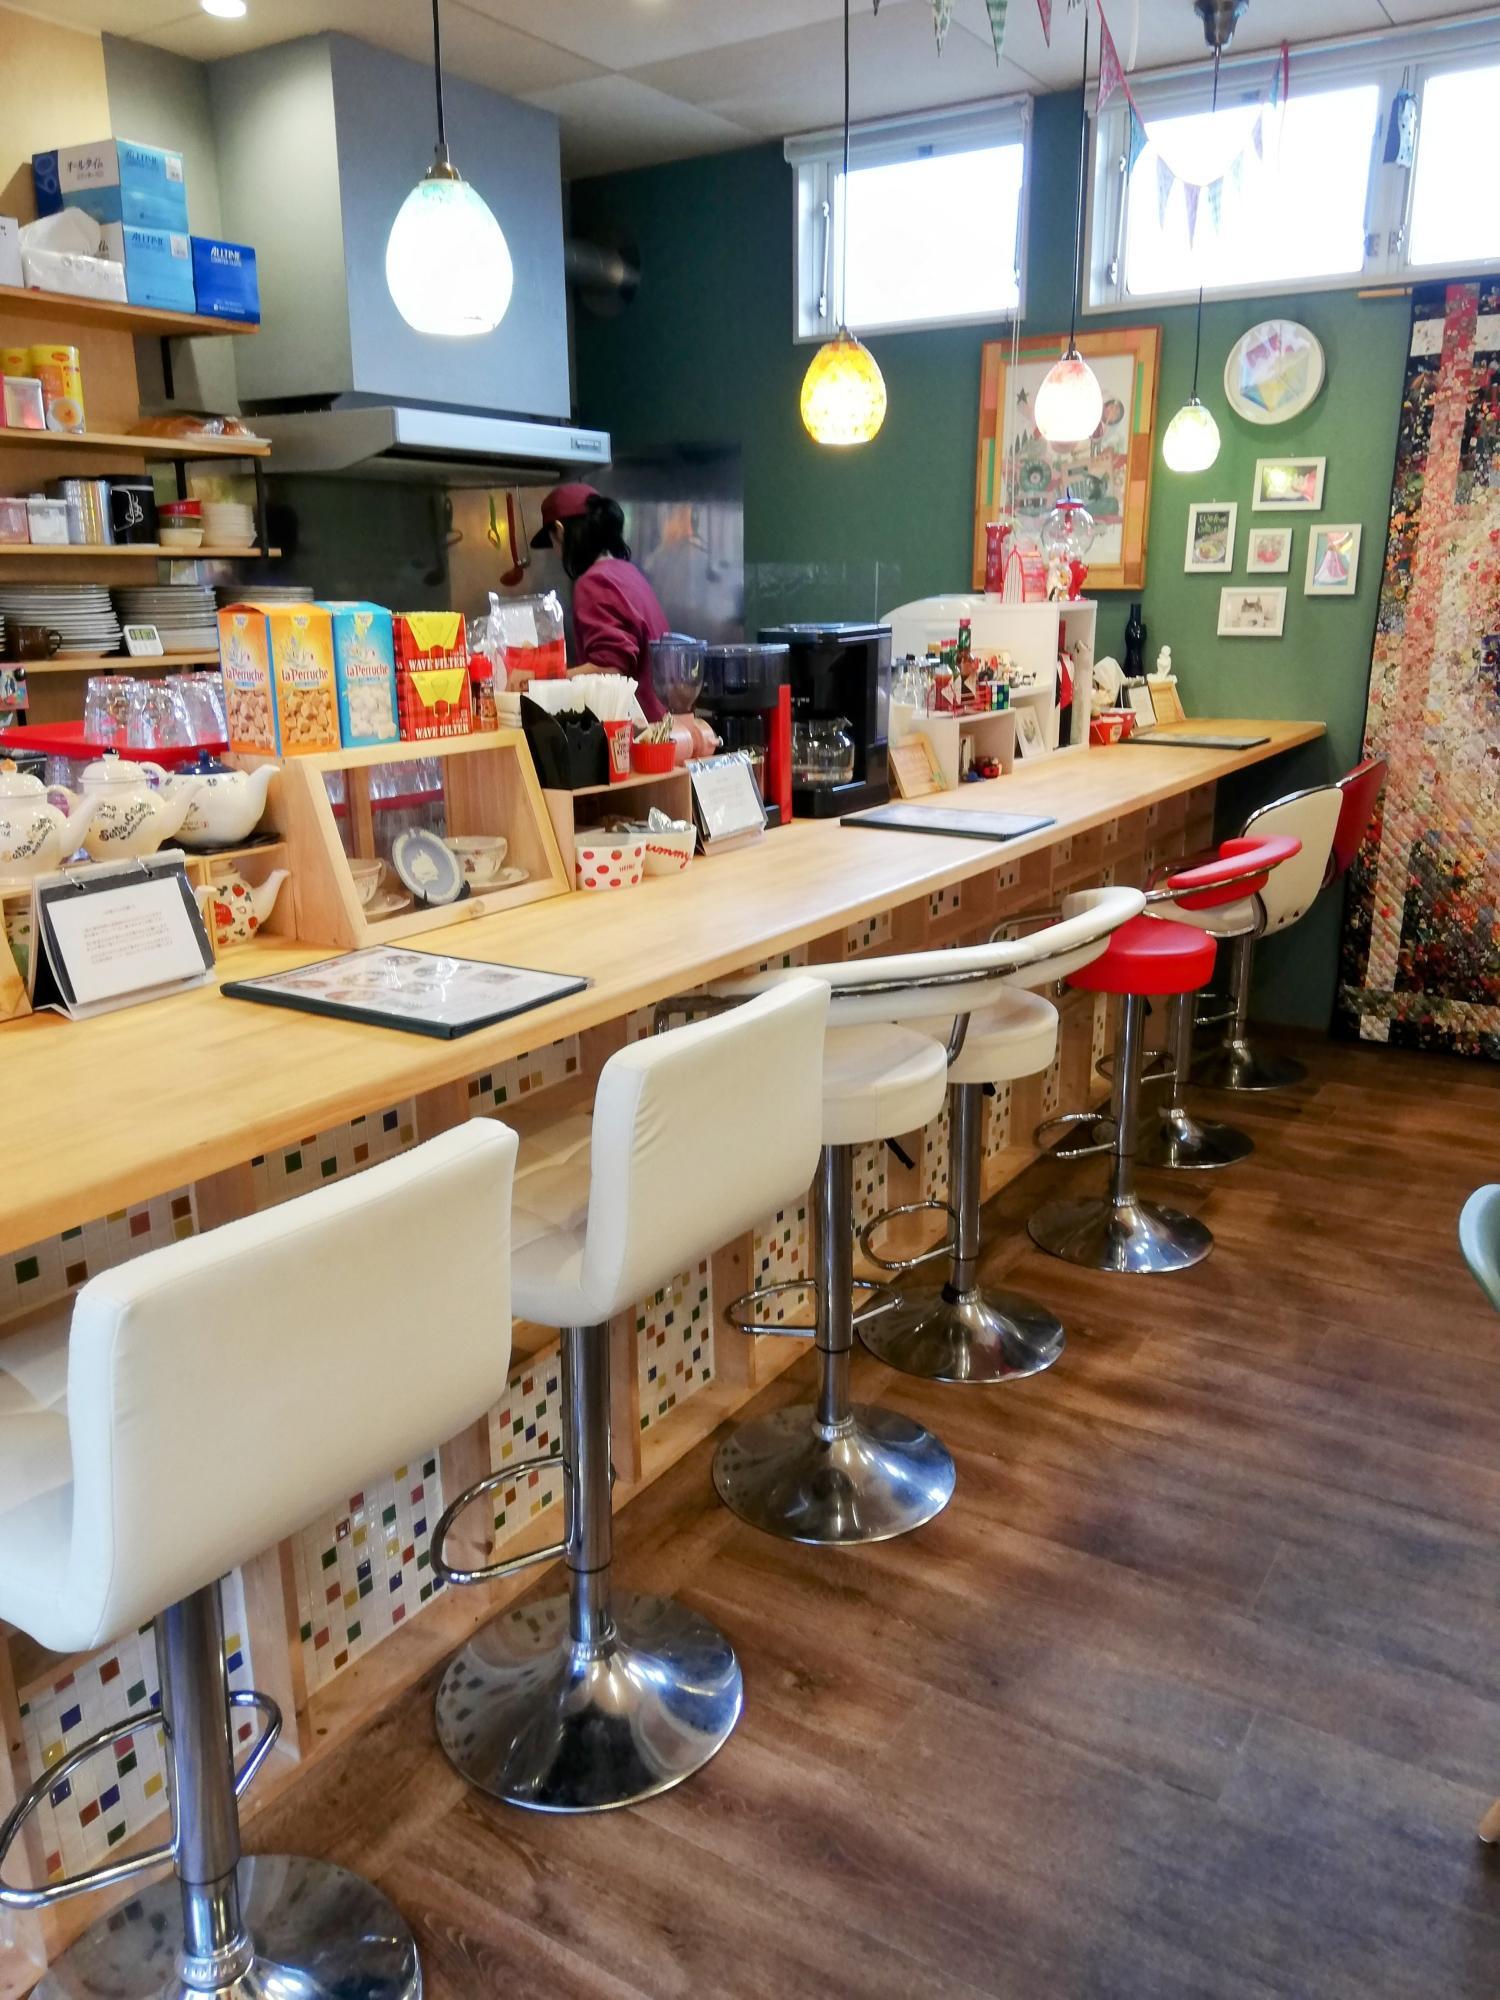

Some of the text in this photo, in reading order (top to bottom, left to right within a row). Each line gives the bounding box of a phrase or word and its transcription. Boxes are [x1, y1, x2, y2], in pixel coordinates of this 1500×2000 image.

[132, 232, 163, 246] ALLTIME
[211, 246, 240, 260] ALLTIME
[353, 663, 389, 677] Perruche
[408, 658, 432, 672] WAVE
[434, 656, 466, 670] FILTER
[231, 667, 264, 681] Perruche
[289, 668, 329, 681] Perruche
[415, 726, 438, 739] WAVE
[440, 722, 469, 736] FILTER
[645, 843, 690, 869] ummy
